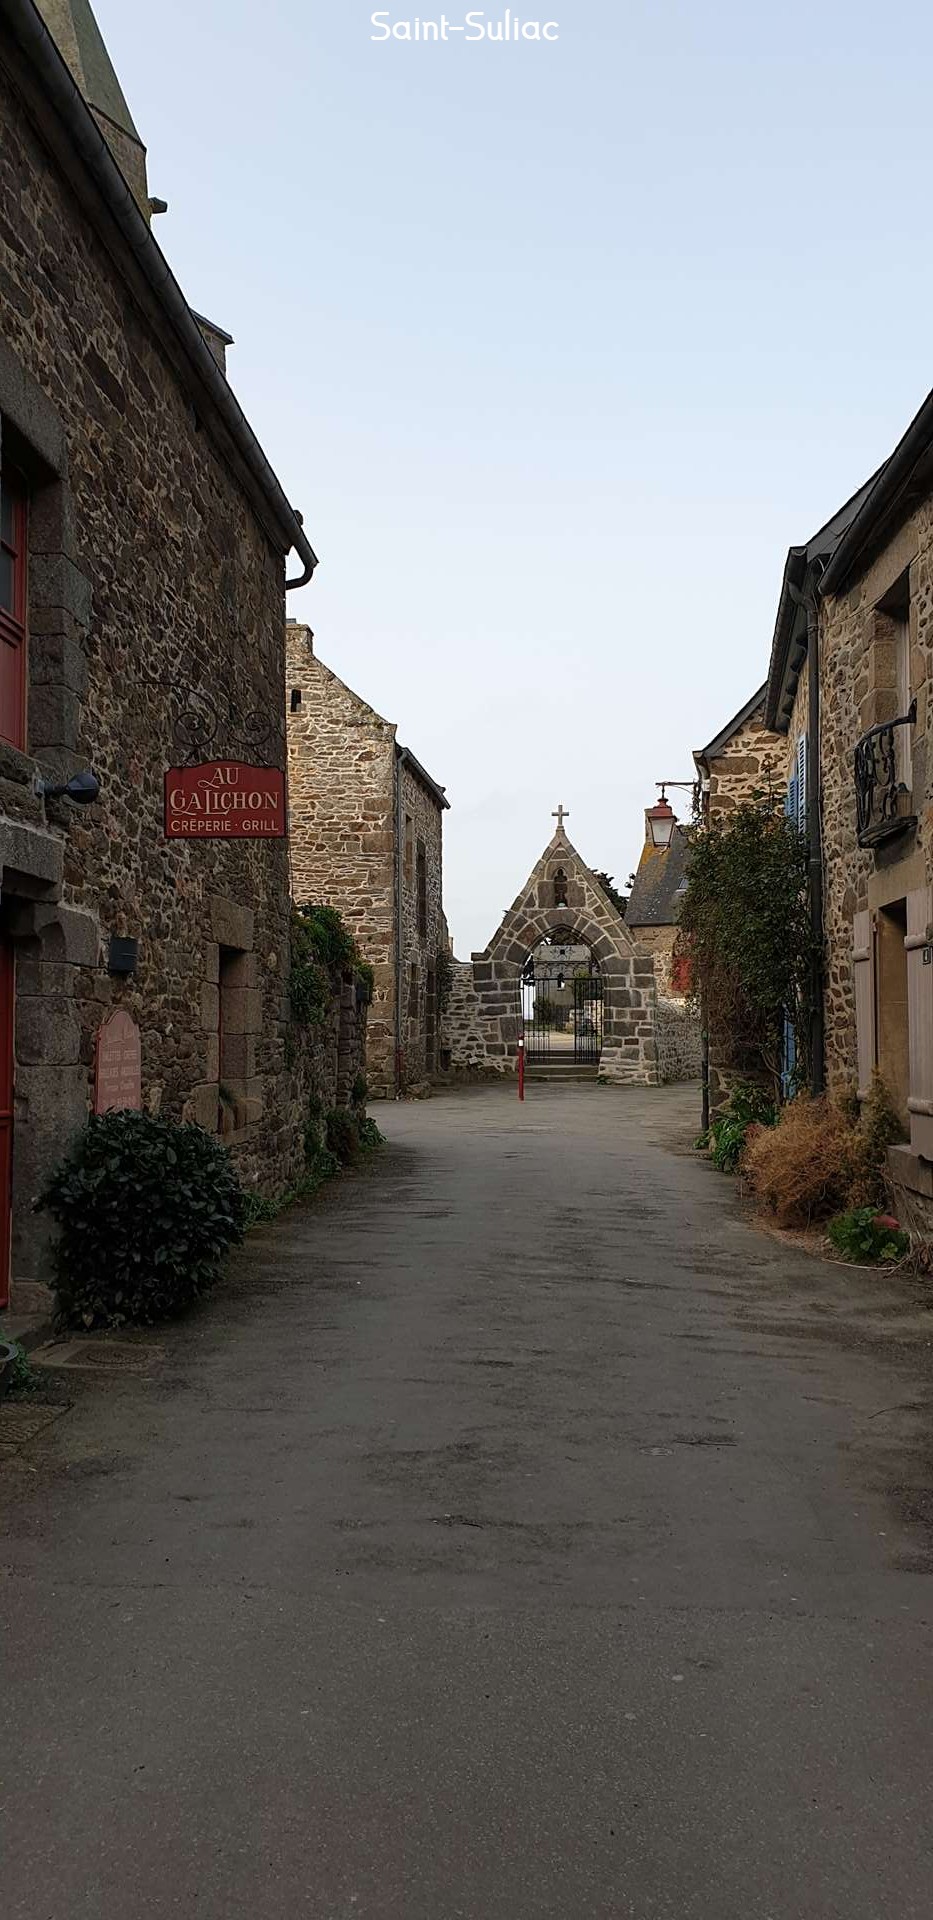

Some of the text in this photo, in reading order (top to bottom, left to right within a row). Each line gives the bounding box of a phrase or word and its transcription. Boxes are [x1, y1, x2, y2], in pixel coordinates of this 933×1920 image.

[198, 767, 240, 789] AU
[171, 819, 279, 832] CRÊPERIE GRILL
